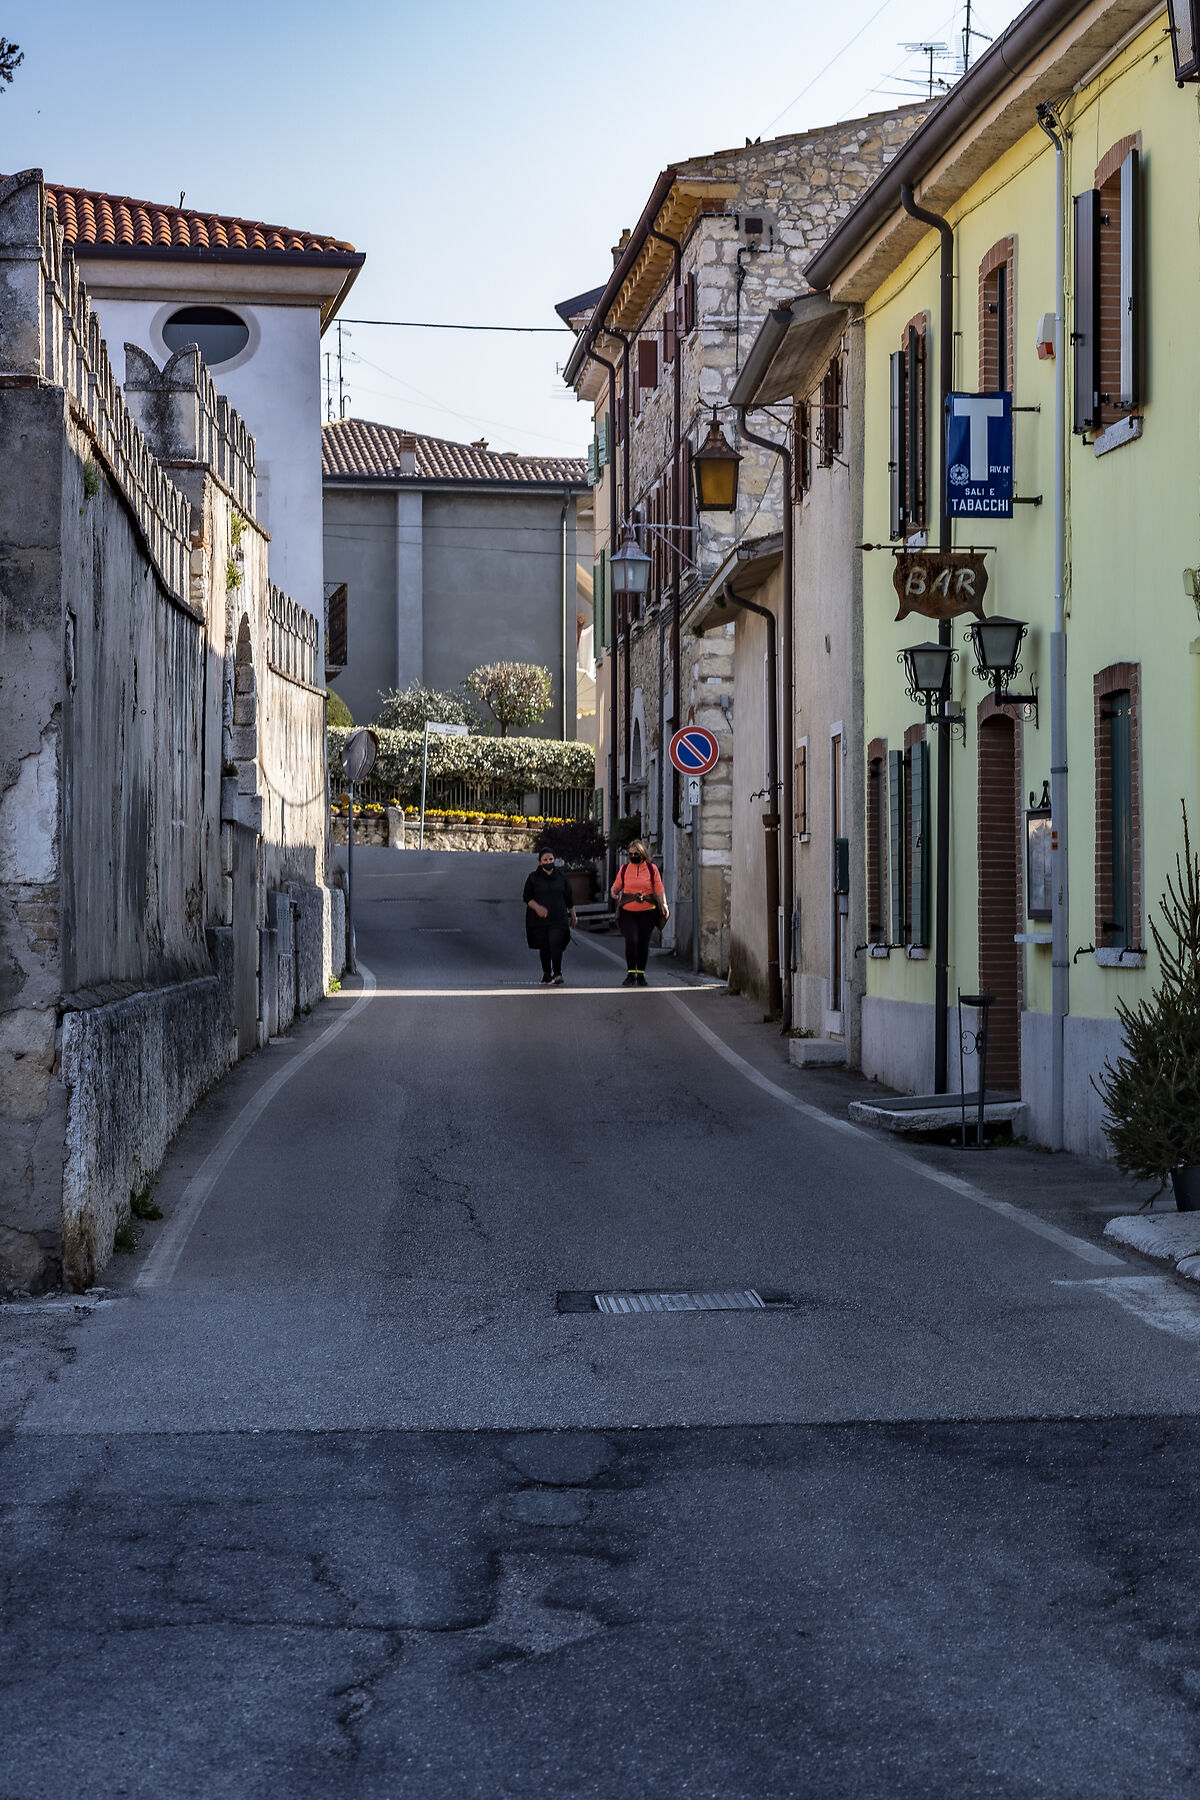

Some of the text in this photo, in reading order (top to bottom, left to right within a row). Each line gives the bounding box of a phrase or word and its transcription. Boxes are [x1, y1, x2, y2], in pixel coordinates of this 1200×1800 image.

[953, 398, 1004, 481] T
[964, 487, 995, 496] SALI E
[951, 498, 1009, 512] TABACCHI
[906, 567, 976, 597] BAR
